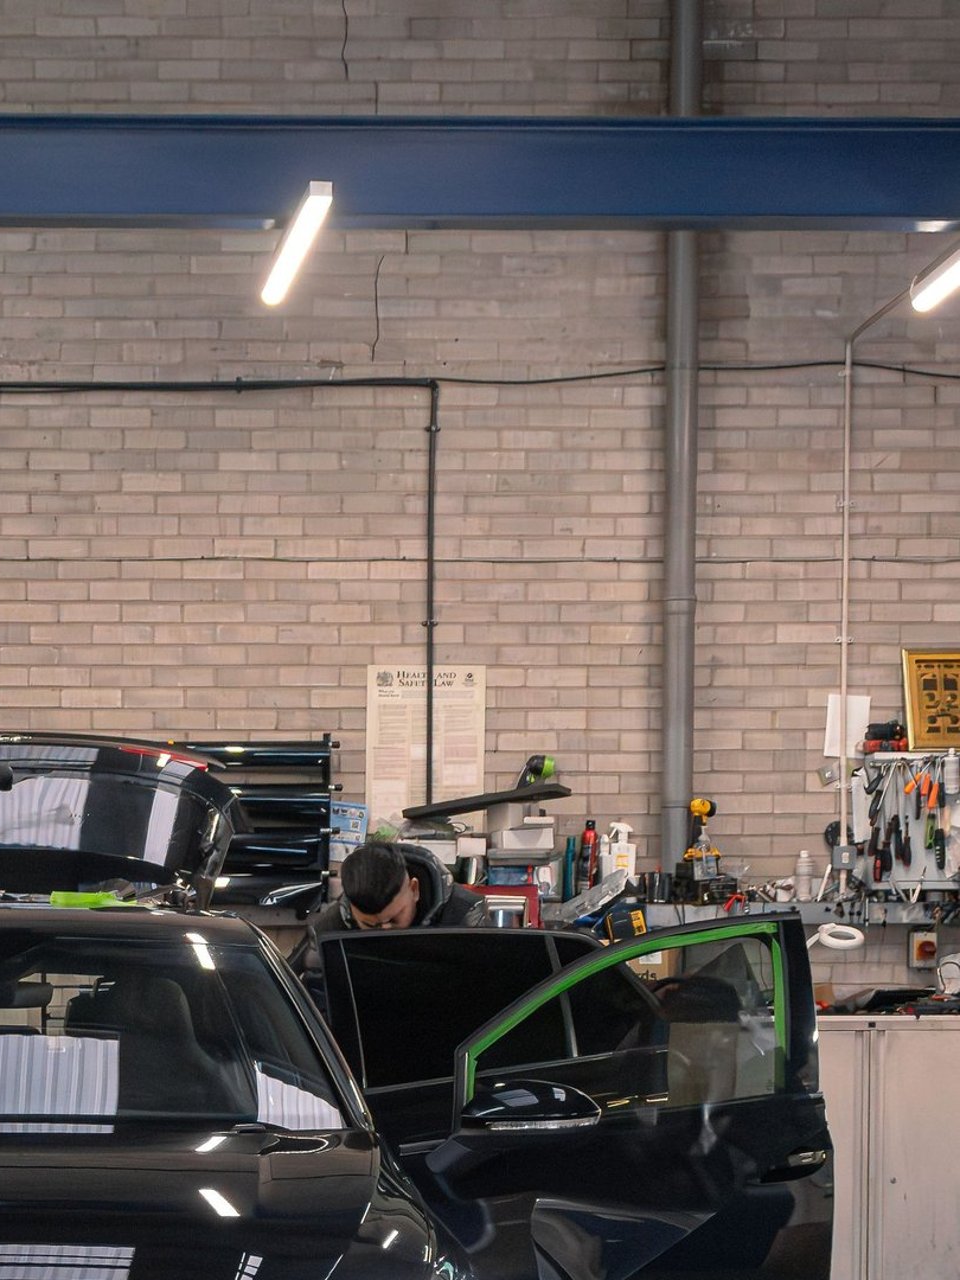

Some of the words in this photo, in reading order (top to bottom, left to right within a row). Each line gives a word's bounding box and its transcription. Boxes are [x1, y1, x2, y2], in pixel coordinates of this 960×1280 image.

[397, 671, 428, 679] HEALT
[398, 679, 428, 687] SAFET
[434, 679, 454, 687] LAW
